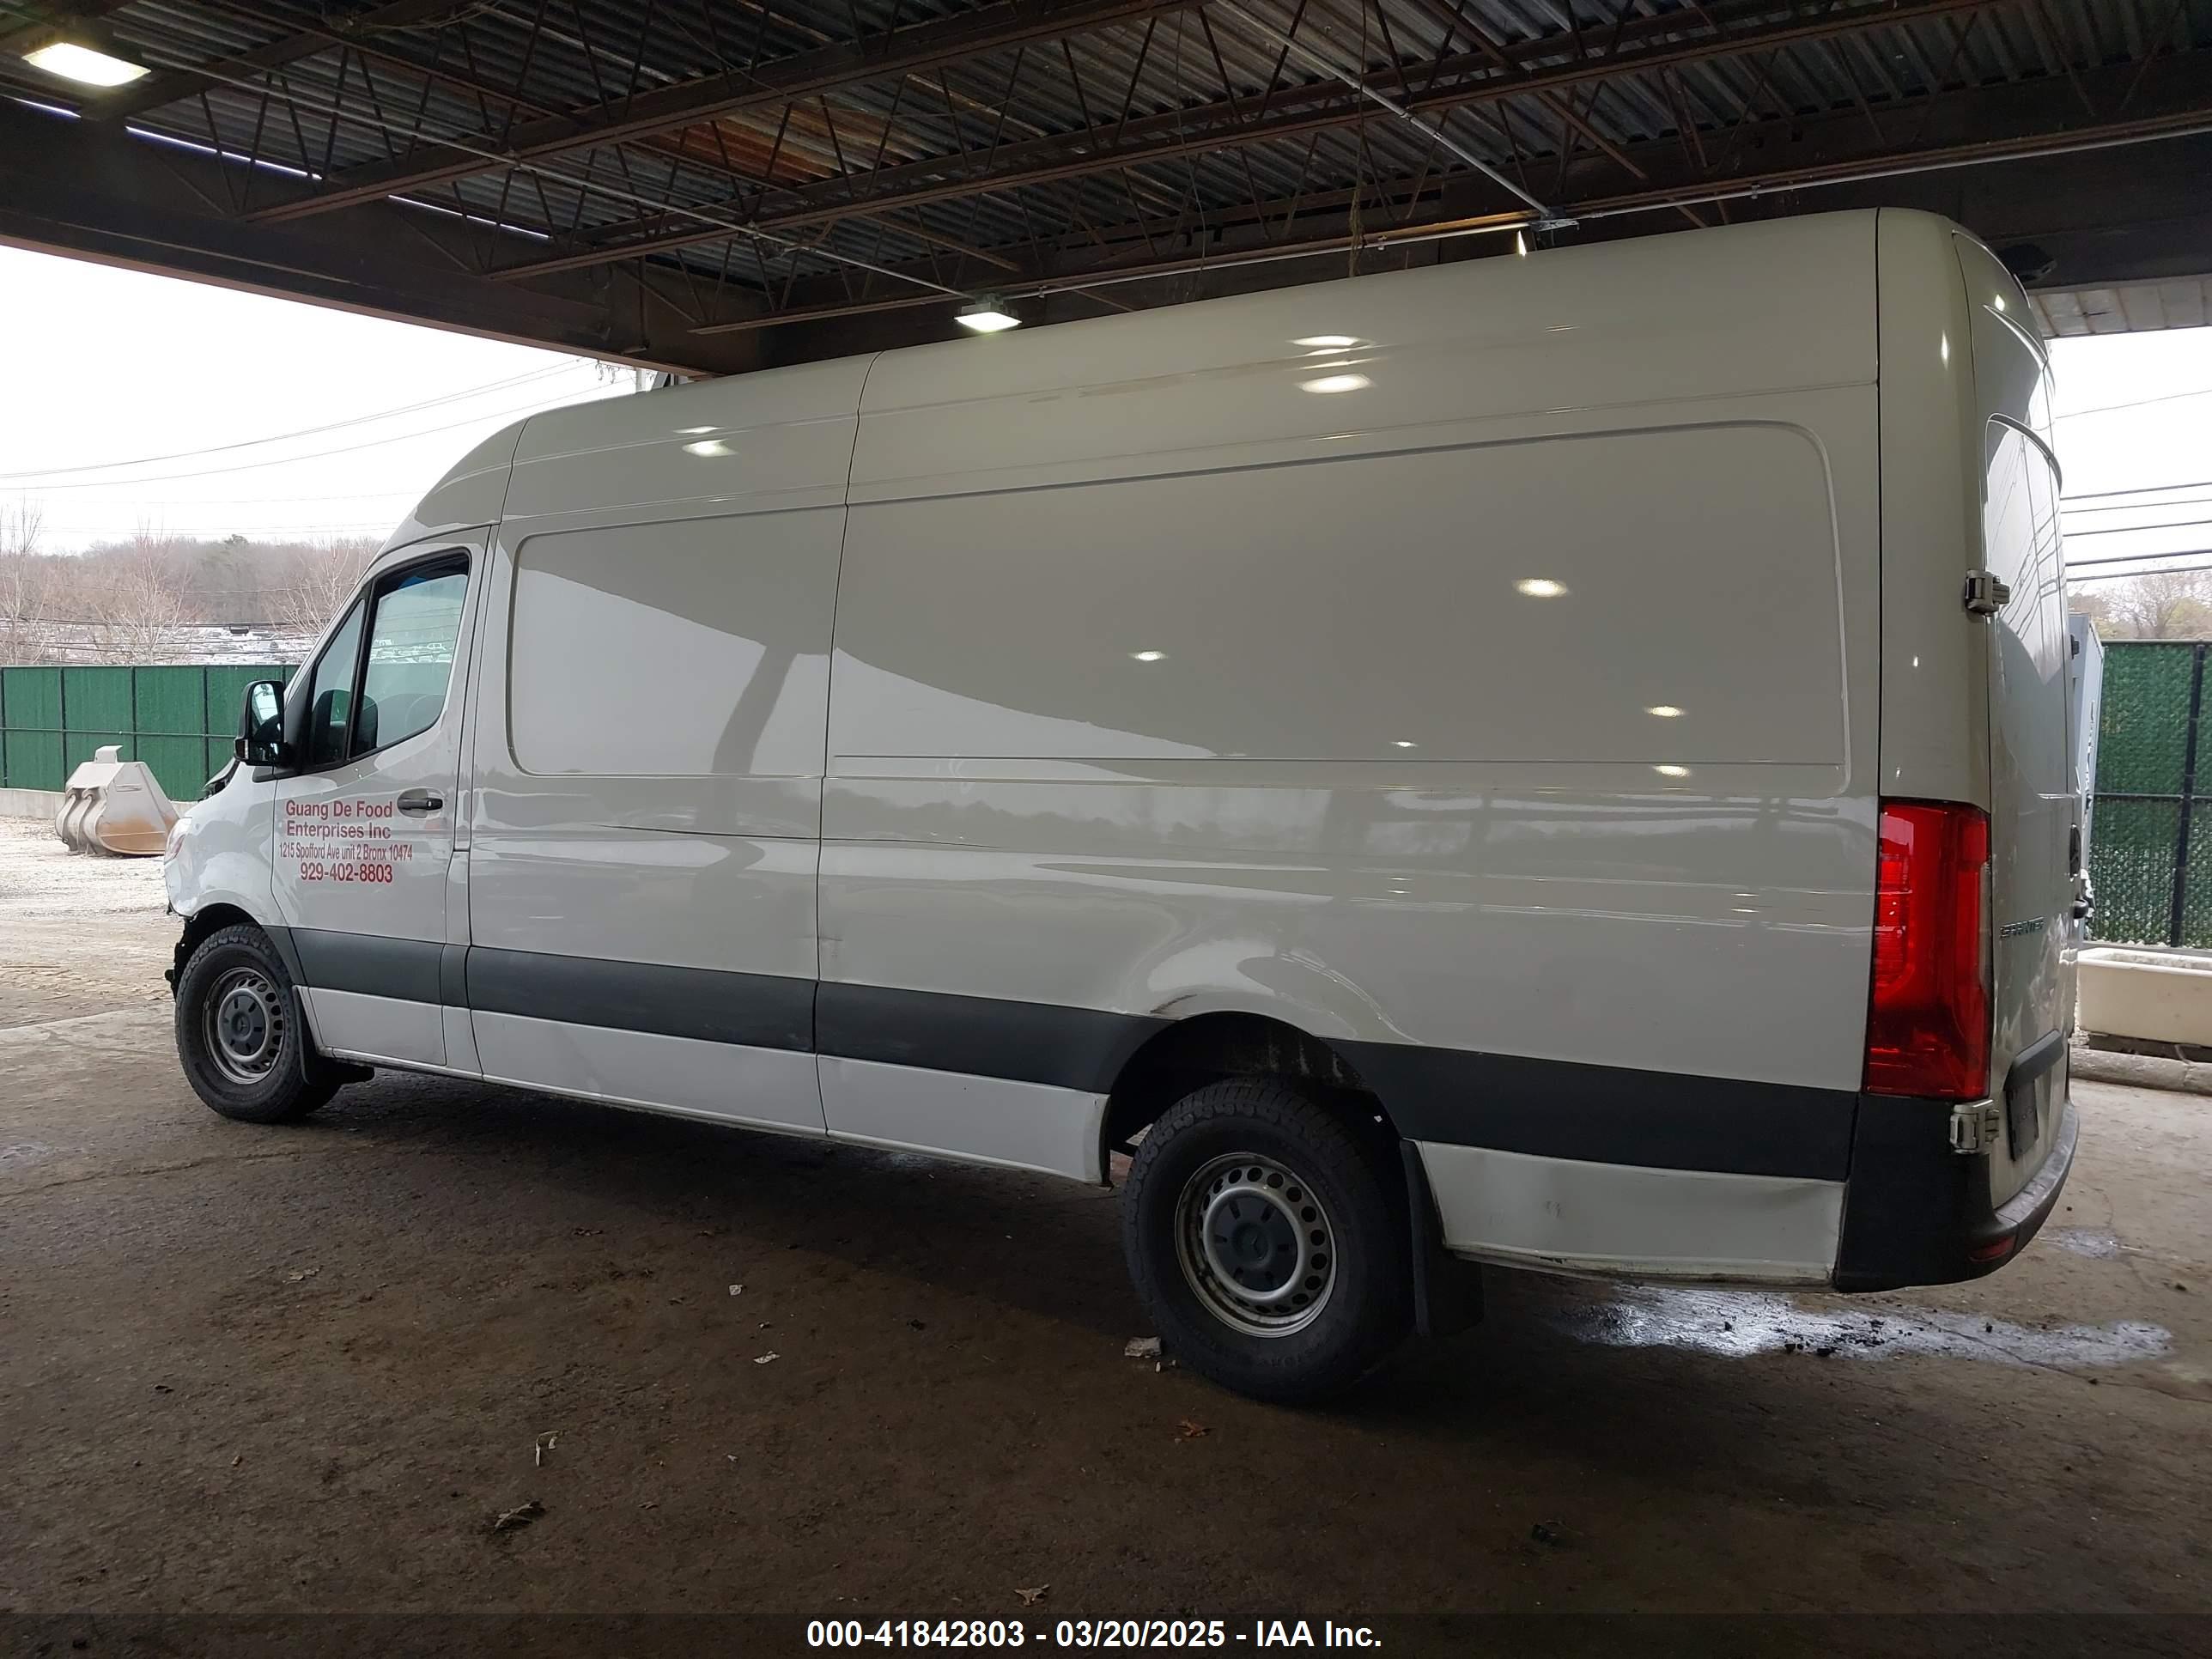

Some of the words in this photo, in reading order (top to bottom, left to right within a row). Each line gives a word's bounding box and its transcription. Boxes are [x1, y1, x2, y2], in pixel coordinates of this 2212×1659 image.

[286, 799, 328, 820] Guang
[334, 800, 352, 817] De
[356, 801, 392, 817] Food
[287, 820, 364, 841] Enterprises
[369, 822, 392, 839] Inc
[279, 842, 295, 858] 1215
[296, 842, 325, 861] Spofford
[327, 843, 340, 860] Ave
[341, 844, 356, 860] unit
[356, 844, 362, 860] 2
[363, 844, 386, 860] Bronx
[389, 844, 412, 861] 10474
[301, 862, 393, 883] 929-402-8803
